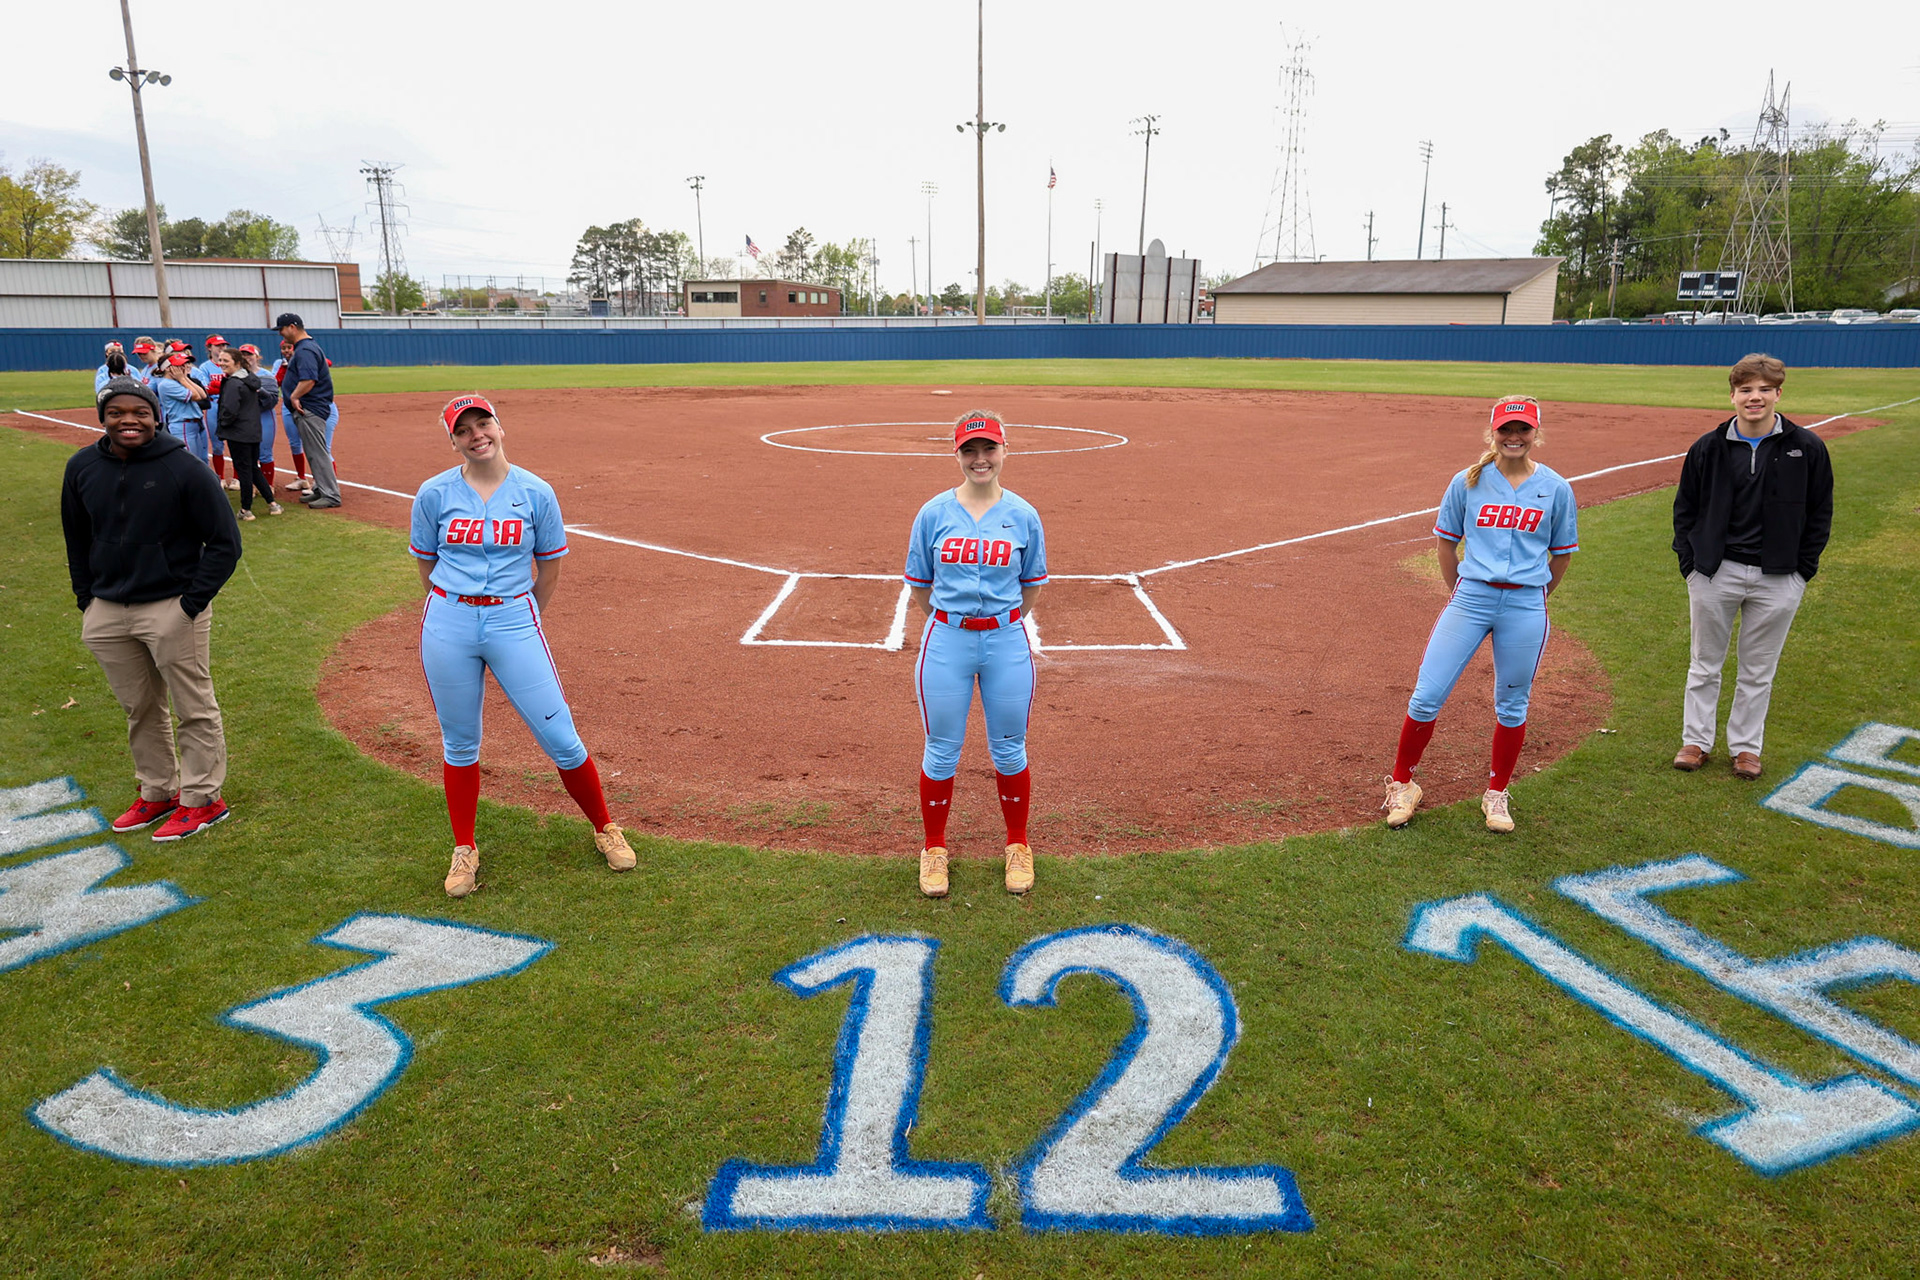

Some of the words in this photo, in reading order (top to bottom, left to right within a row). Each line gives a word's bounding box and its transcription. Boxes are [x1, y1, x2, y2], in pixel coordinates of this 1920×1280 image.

[446, 518, 523, 546] SBA
[1475, 503, 1546, 533] SBA
[940, 537, 1012, 567] SBA
[25, 911, 558, 1168] 3
[702, 922, 1314, 1236] 12
